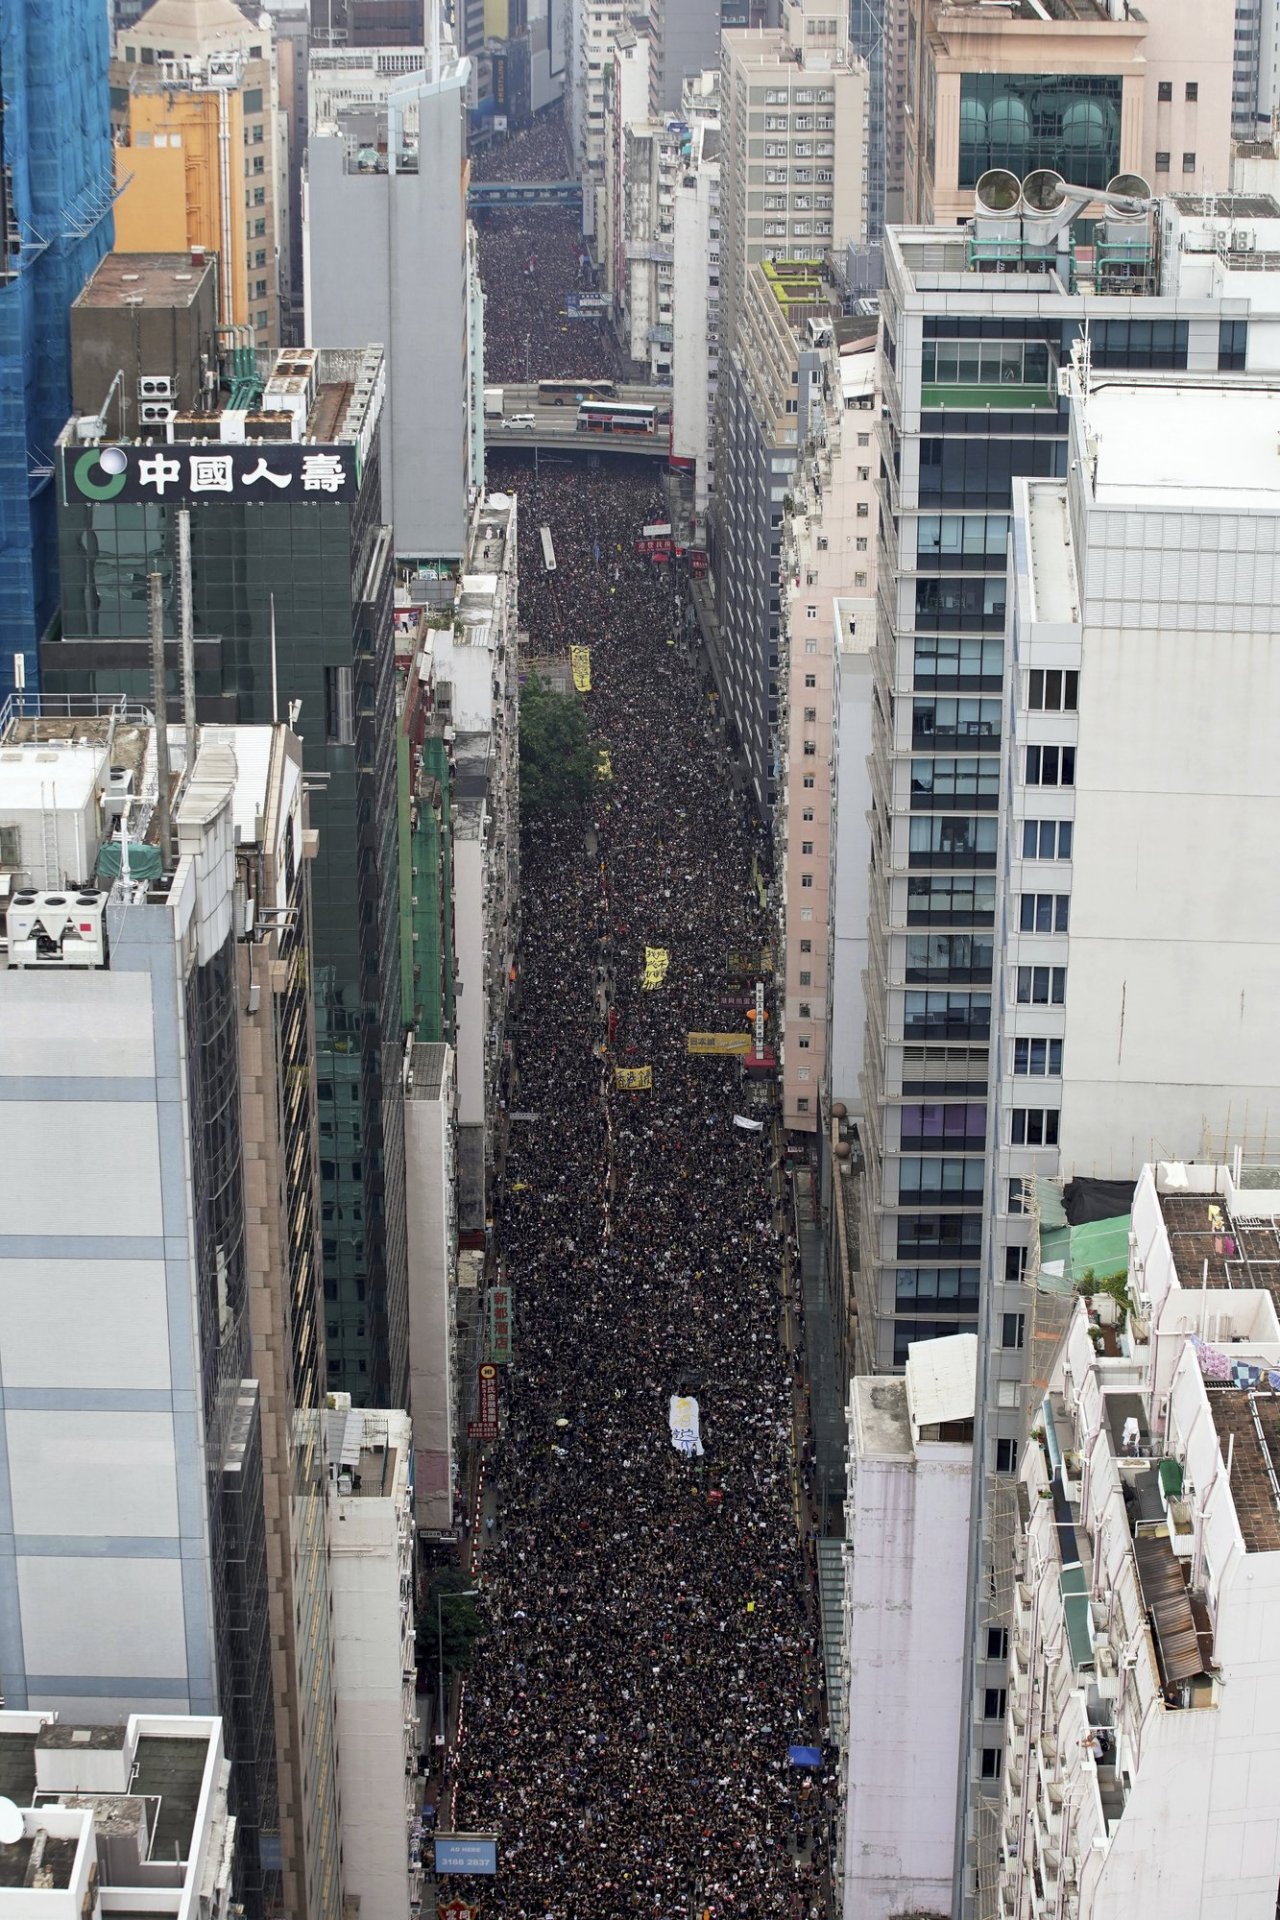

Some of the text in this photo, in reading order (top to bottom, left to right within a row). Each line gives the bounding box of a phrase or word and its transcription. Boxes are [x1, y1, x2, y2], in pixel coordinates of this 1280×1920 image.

[139, 453, 346, 495] 中國人壽
[494, 1292, 508, 1349] 新都酒店
